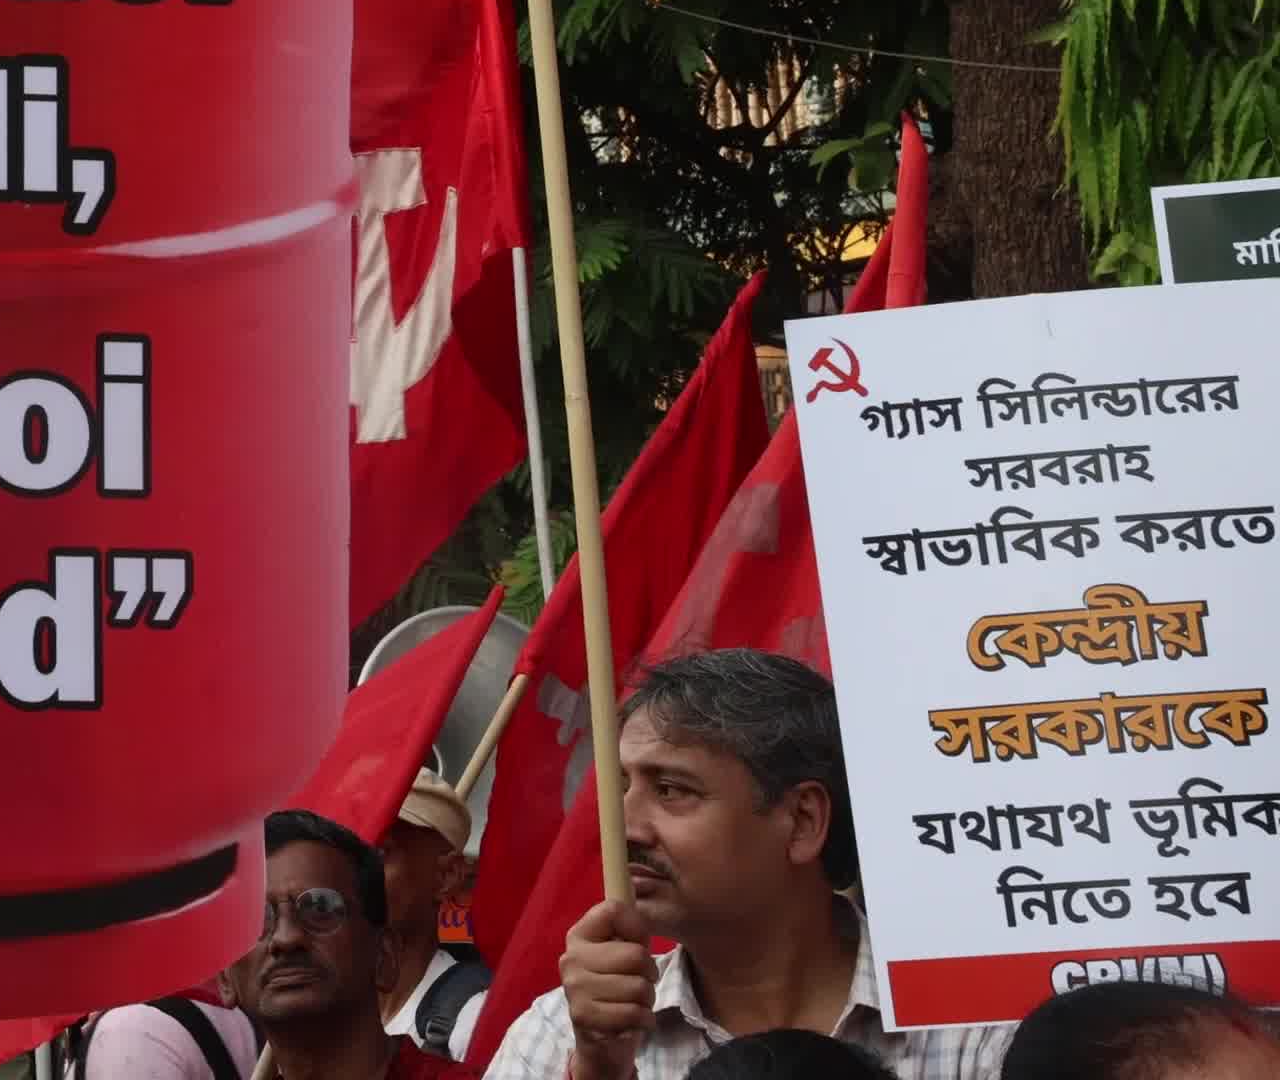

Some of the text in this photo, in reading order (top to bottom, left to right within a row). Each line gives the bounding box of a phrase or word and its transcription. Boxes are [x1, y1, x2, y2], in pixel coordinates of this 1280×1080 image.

[860, 373, 1240, 439] গ্যাস সিলিন্ডারের
[964, 445, 1155, 491] সরবরাহ
[862, 505, 1277, 575] স্বাভাবিক করতে
[966, 583, 1209, 672] কেন্দ্রীয়
[928, 688, 1269, 763] সরকারকে
[912, 798, 1111, 854] যথাযথ
[997, 866, 1251, 928] নিতে হবে
